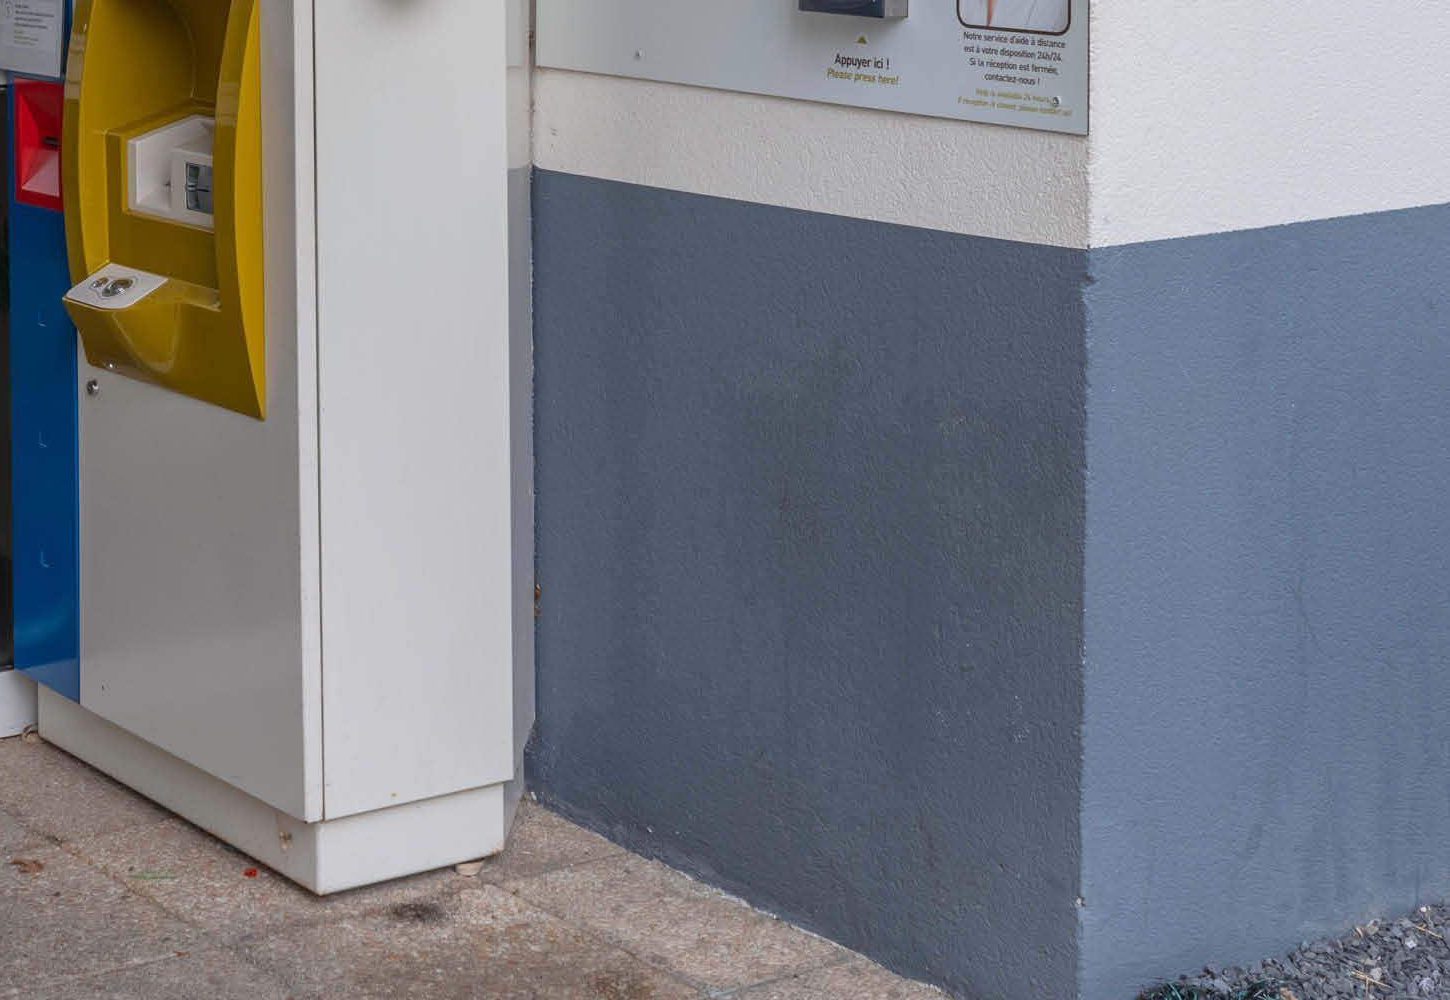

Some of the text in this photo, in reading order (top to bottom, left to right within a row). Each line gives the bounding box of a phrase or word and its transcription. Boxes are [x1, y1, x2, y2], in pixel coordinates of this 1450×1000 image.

[963, 31, 982, 41] Notre
[984, 34, 1008, 43] service
[1037, 38, 1066, 48] distance
[981, 47, 999, 56] votre
[999, 48, 1036, 59] disposition
[834, 52, 871, 70] Appuyer
[873, 56, 884, 69] ici
[985, 59, 1017, 72] réception
[1018, 63, 1030, 72] est
